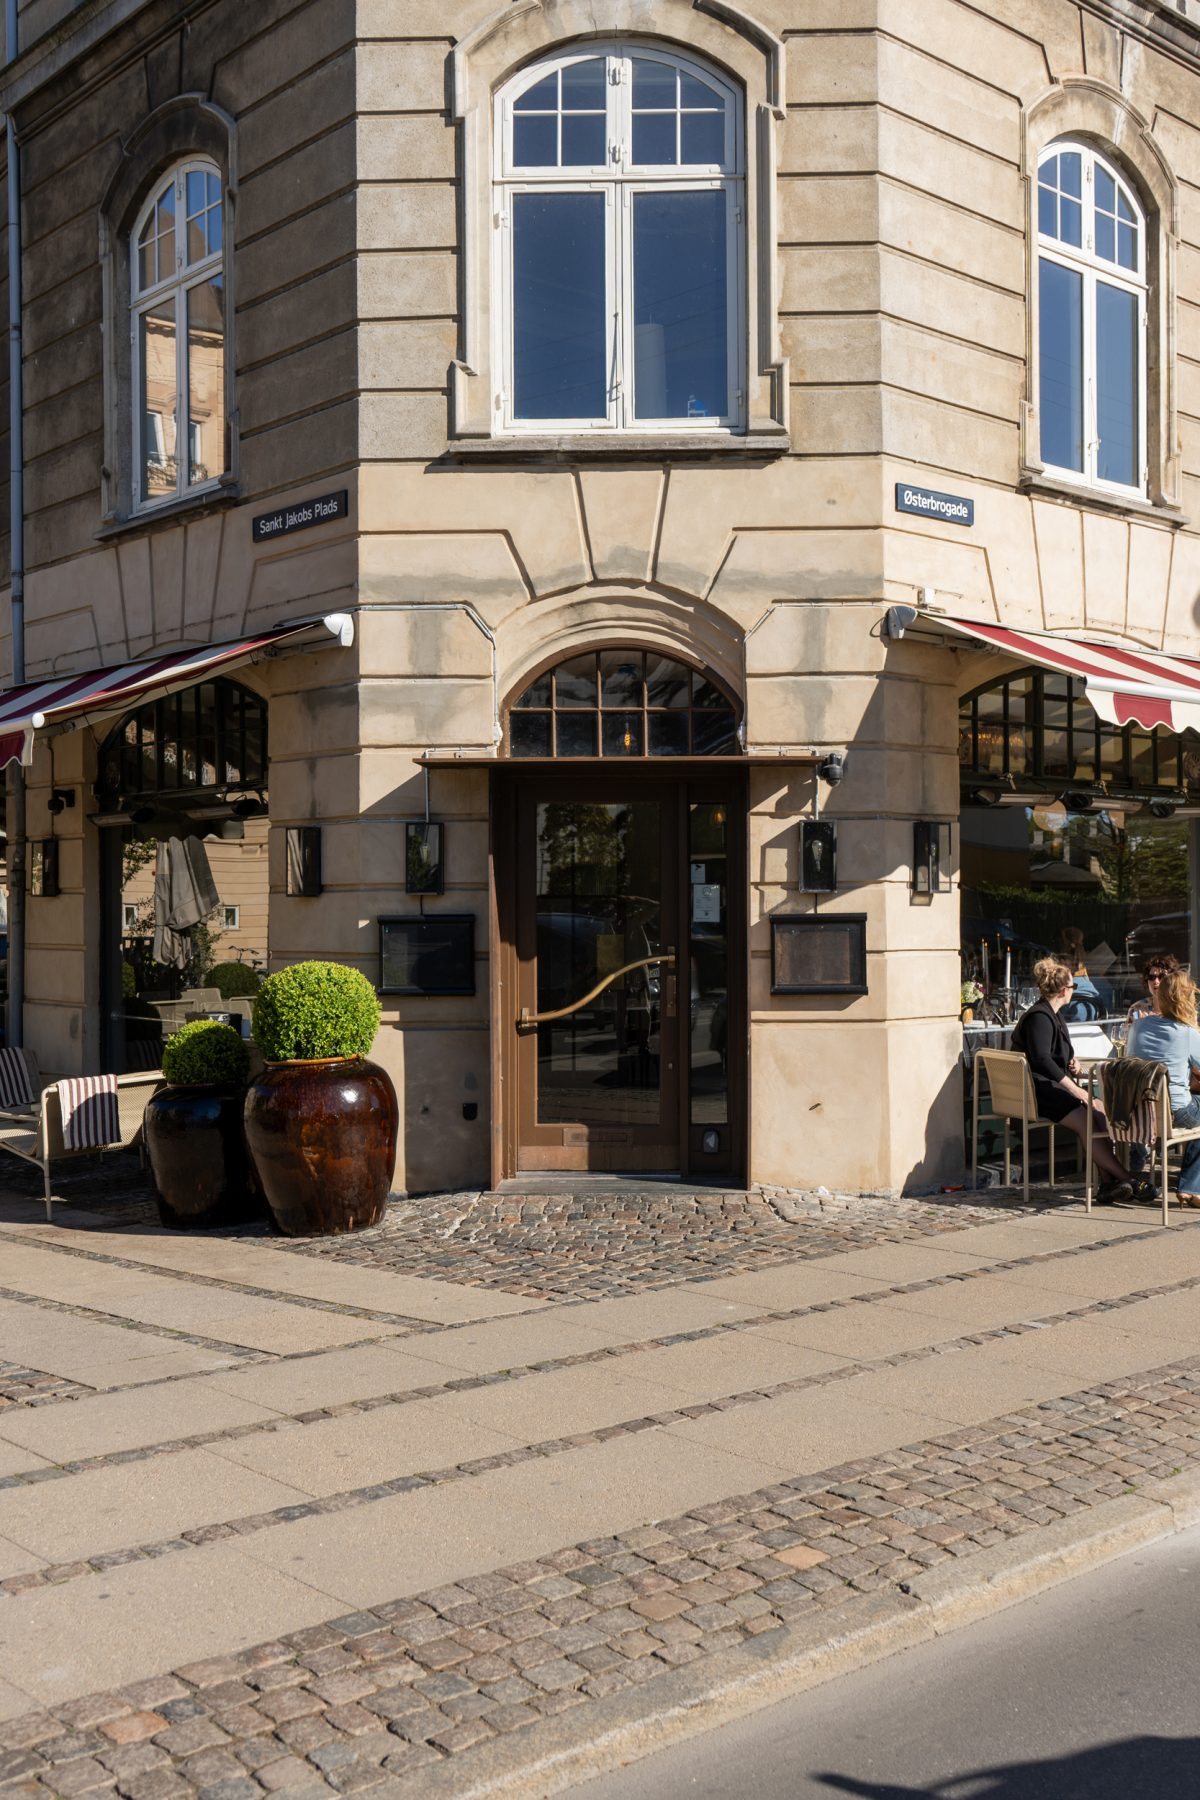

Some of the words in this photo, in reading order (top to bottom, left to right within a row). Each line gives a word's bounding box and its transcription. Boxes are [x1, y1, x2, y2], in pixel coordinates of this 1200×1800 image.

[260, 515, 283, 534] Sankt
[285, 508, 313, 529] Jakobs
[314, 500, 338, 518] Plads
[904, 490, 968, 517] Østerbrogade
